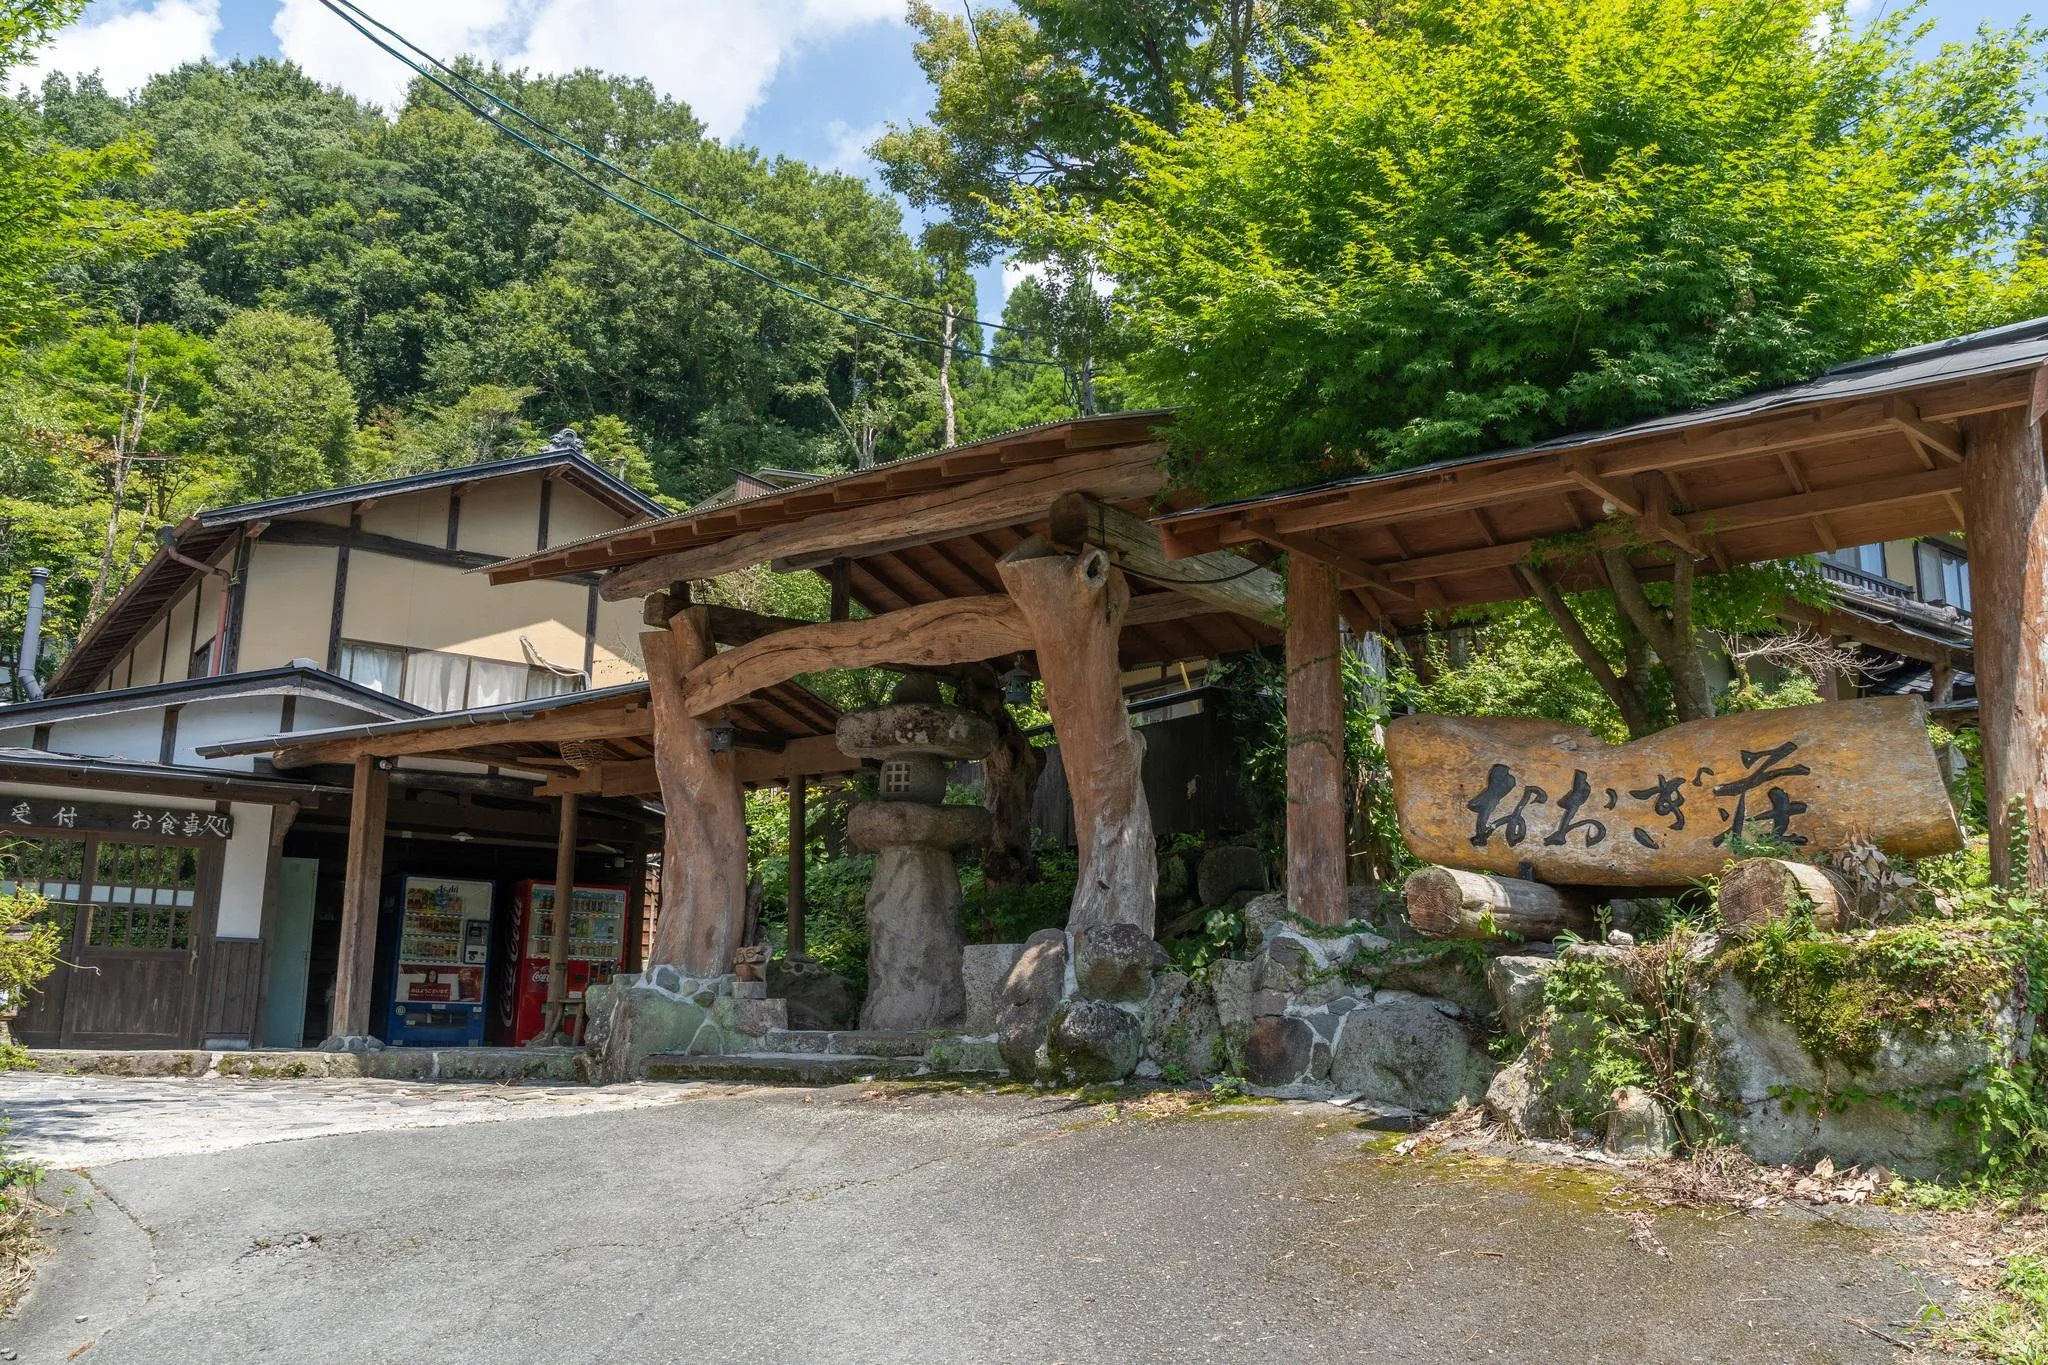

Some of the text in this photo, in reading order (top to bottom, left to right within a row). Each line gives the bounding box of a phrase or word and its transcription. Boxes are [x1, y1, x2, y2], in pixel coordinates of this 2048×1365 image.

[132, 810, 230, 838] お食事処
[438, 884, 459, 894] Asahi
